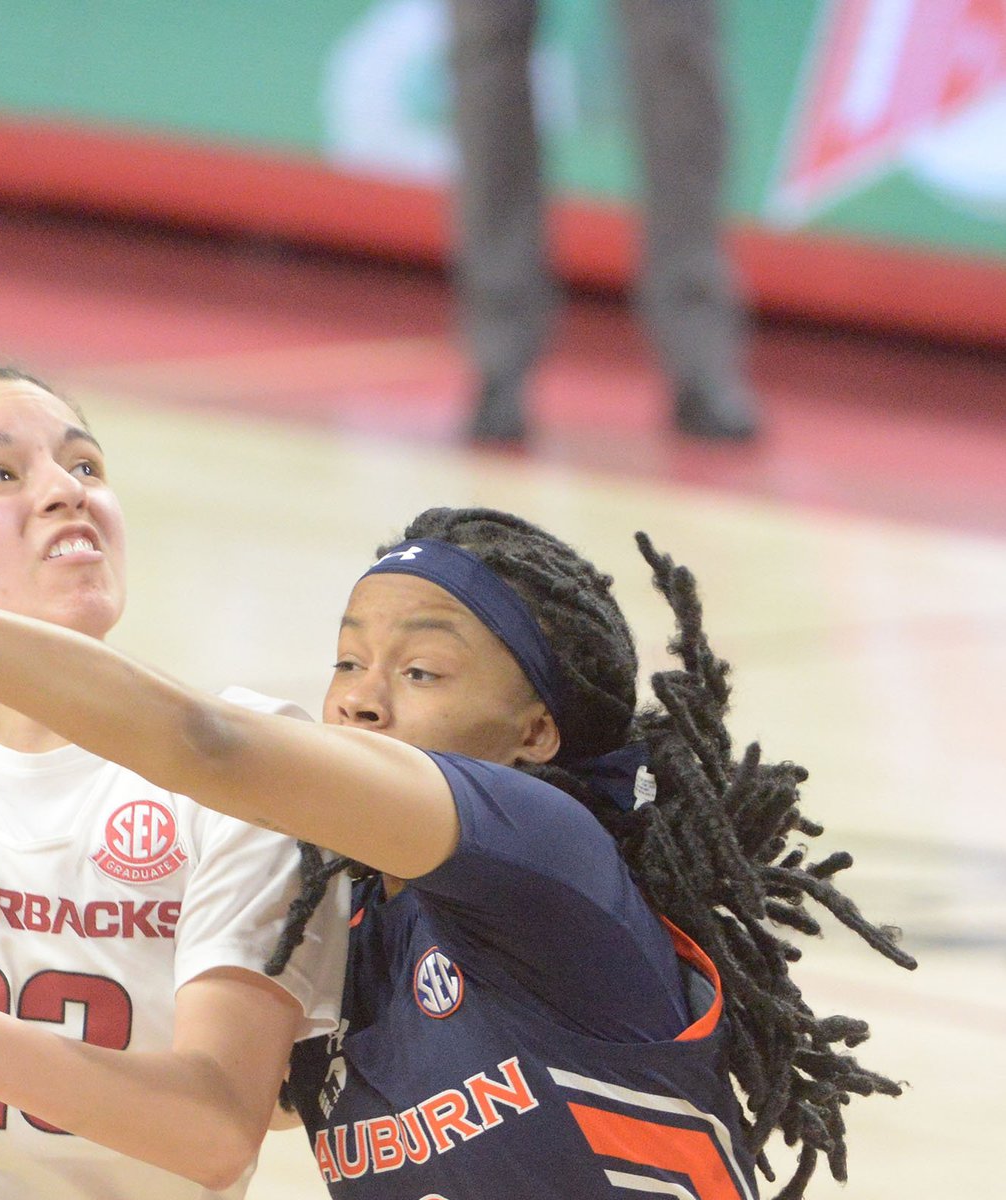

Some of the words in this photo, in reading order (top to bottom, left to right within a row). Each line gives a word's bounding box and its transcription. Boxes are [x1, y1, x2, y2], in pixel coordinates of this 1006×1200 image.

[111, 804, 168, 859] SEC
[106, 860, 172, 880] GRADUATE
[417, 952, 459, 1013] SEC
[315, 1056, 539, 1183] AUBURN
